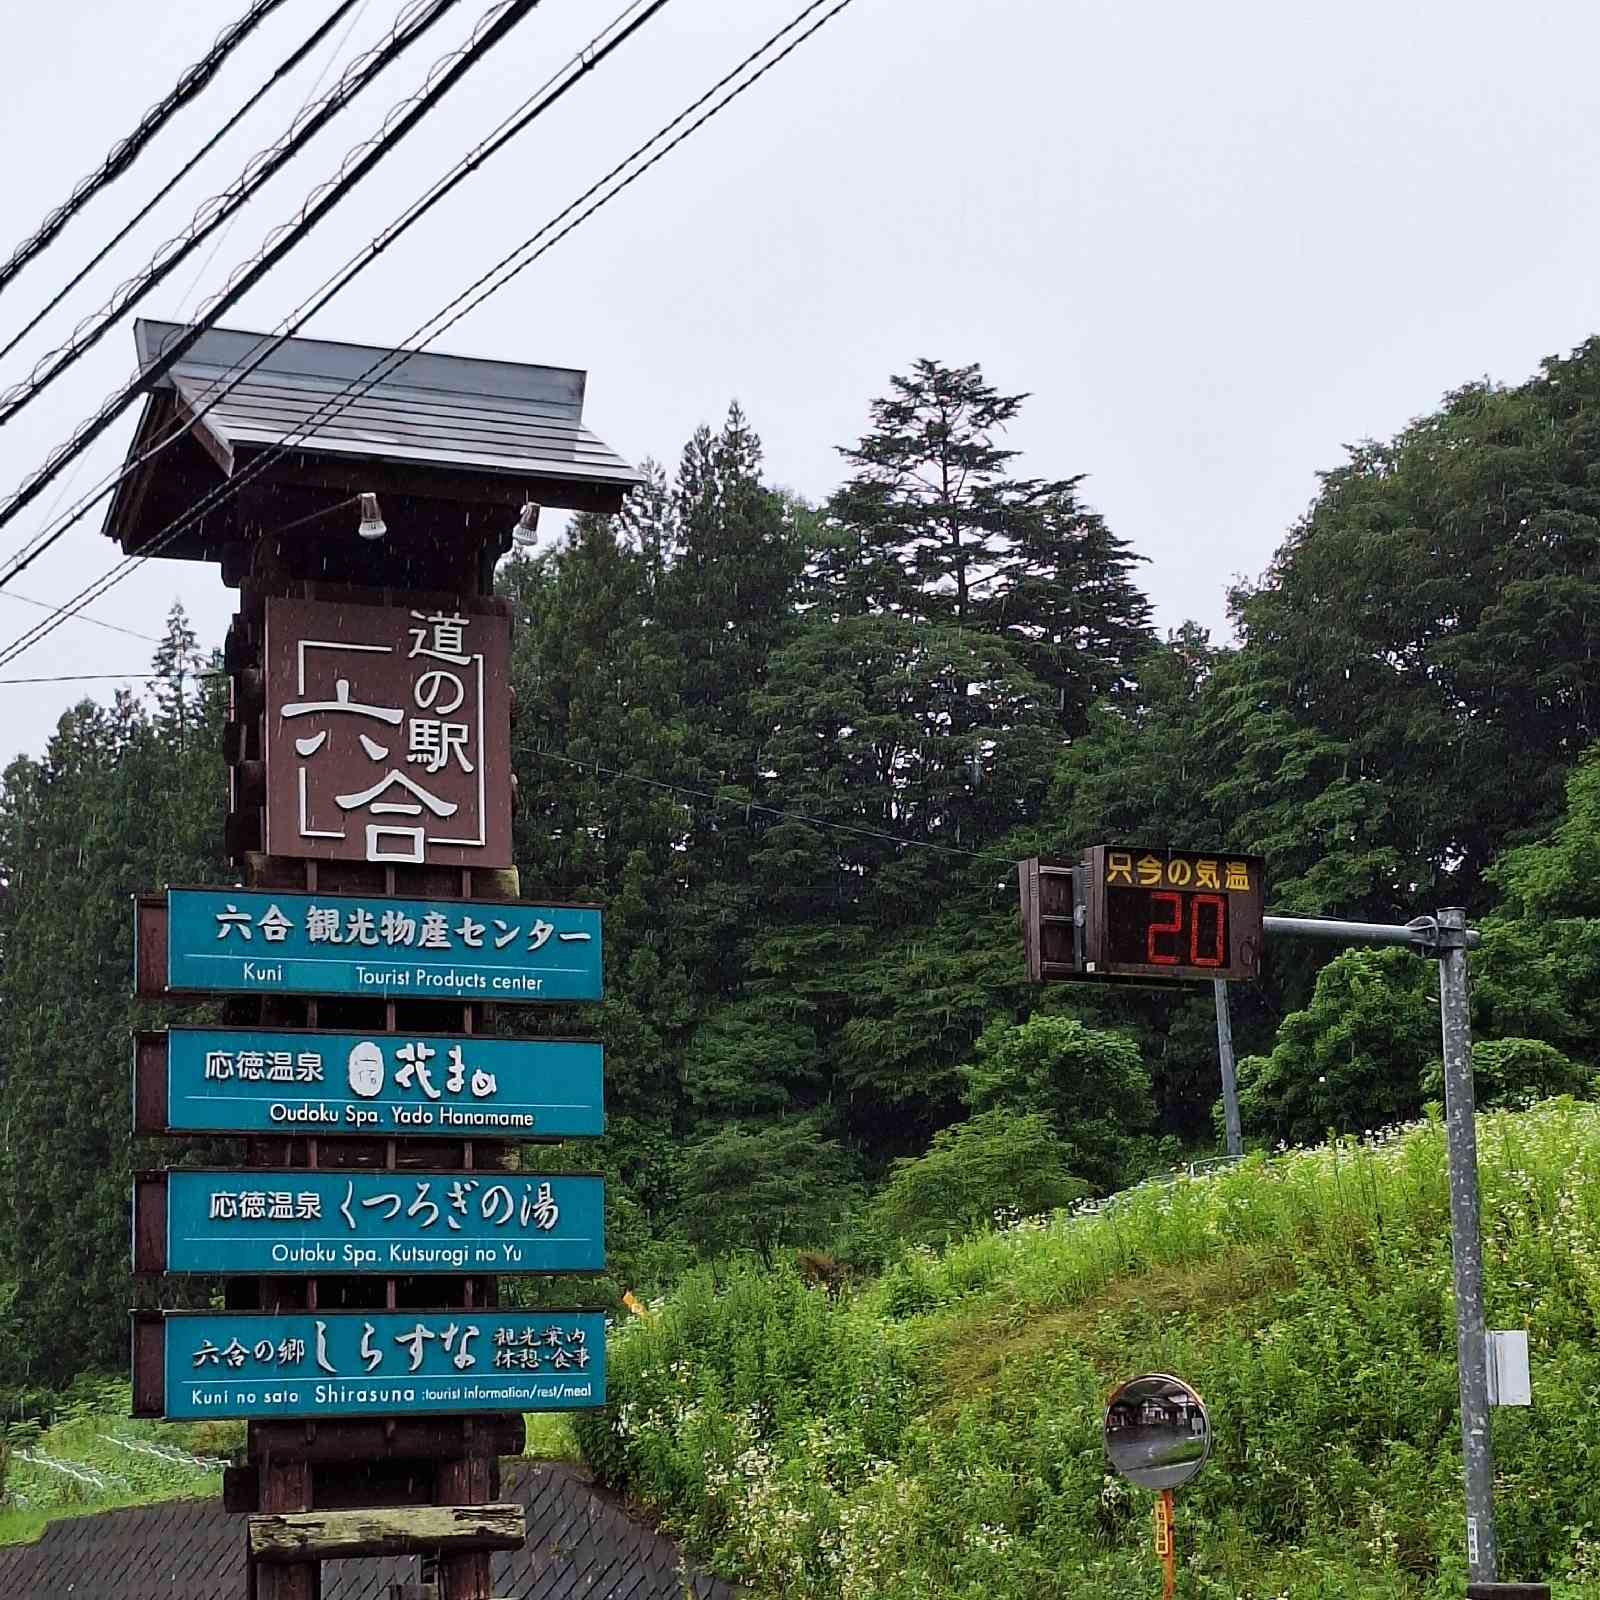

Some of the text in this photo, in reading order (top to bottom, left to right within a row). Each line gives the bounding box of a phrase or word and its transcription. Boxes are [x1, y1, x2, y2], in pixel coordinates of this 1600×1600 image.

[407, 610, 473, 773] 道の駅
[280, 679, 457, 863] 六合
[1106, 852, 1250, 891] 只今の気温
[215, 904, 592, 950] 六合 観光物産センター
[1147, 891, 1226, 966] 20
[243, 962, 543, 991] Kuni Tourist Products center
[204, 1050, 324, 1081] 応徳温泉
[270, 1103, 534, 1129] Oudoku Spa. Yado Hanamame
[208, 1179, 559, 1230] 応徳温泉 くつろぎの湯
[272, 1242, 522, 1267] Outoku Spa. Kutsurogi no Yu
[192, 1320, 480, 1374] 六合の郷 しらすな
[493, 1325, 586, 1346] 観光案内
[192, 1389, 228, 1405] Kuni
[236, 1393, 256, 1404] no
[263, 1389, 299, 1404] sato
[315, 1383, 415, 1404] Shirasuna
